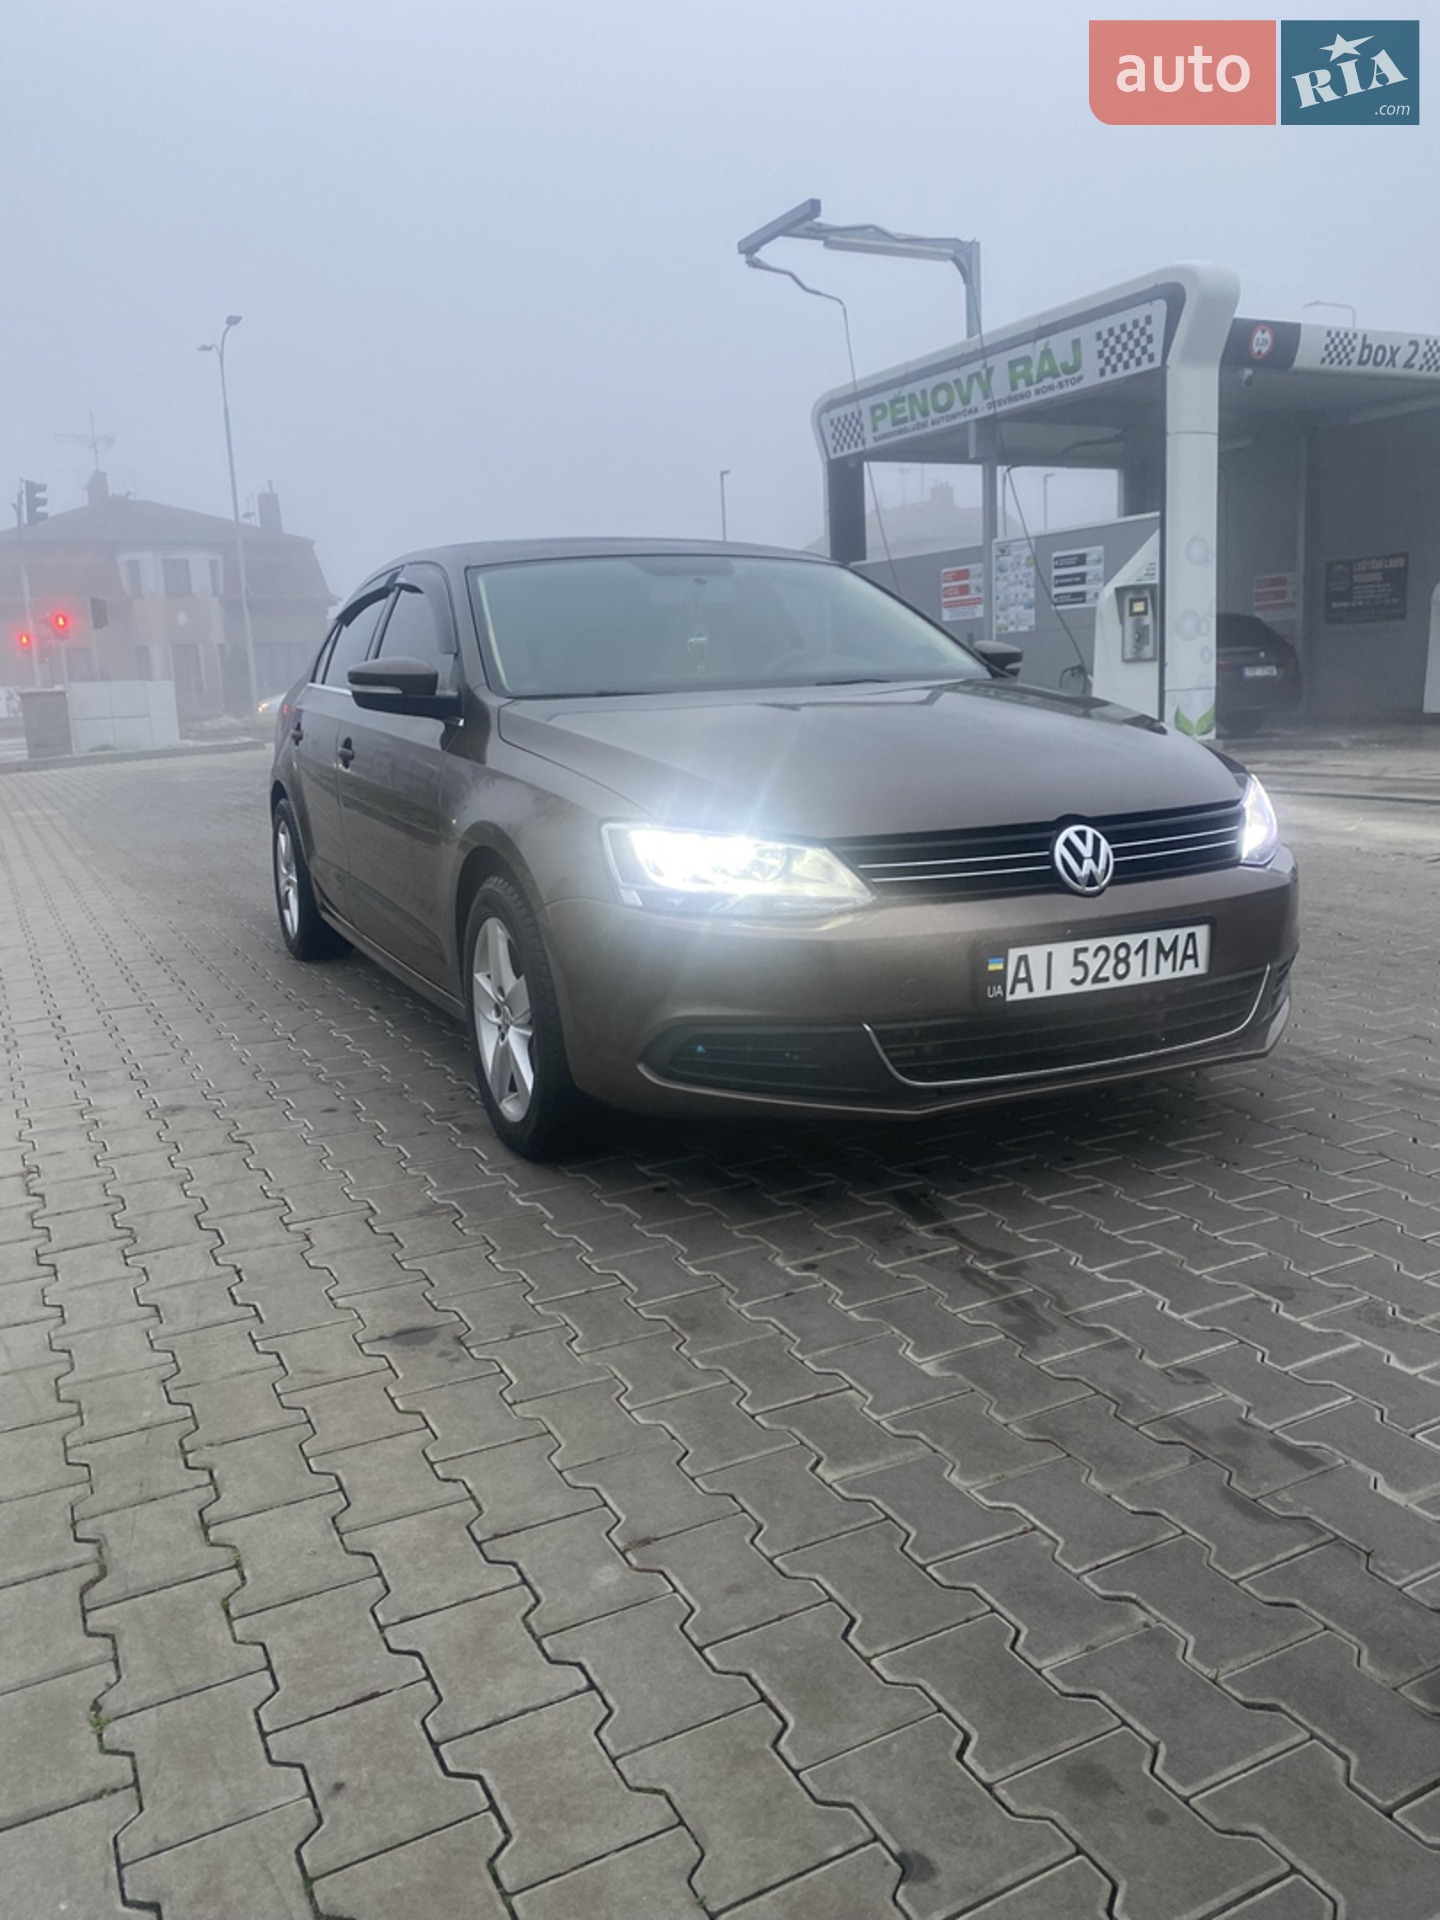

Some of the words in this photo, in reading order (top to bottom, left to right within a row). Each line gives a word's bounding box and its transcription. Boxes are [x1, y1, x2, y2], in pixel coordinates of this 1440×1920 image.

[1008, 337, 1083, 392] RÁJ
[1357, 333, 1401, 369] box
[1402, 339, 1420, 370] 2
[1034, 374, 1084, 396] NON-STOP
[987, 985, 1004, 998] UA
[1009, 950, 1053, 996] AI
